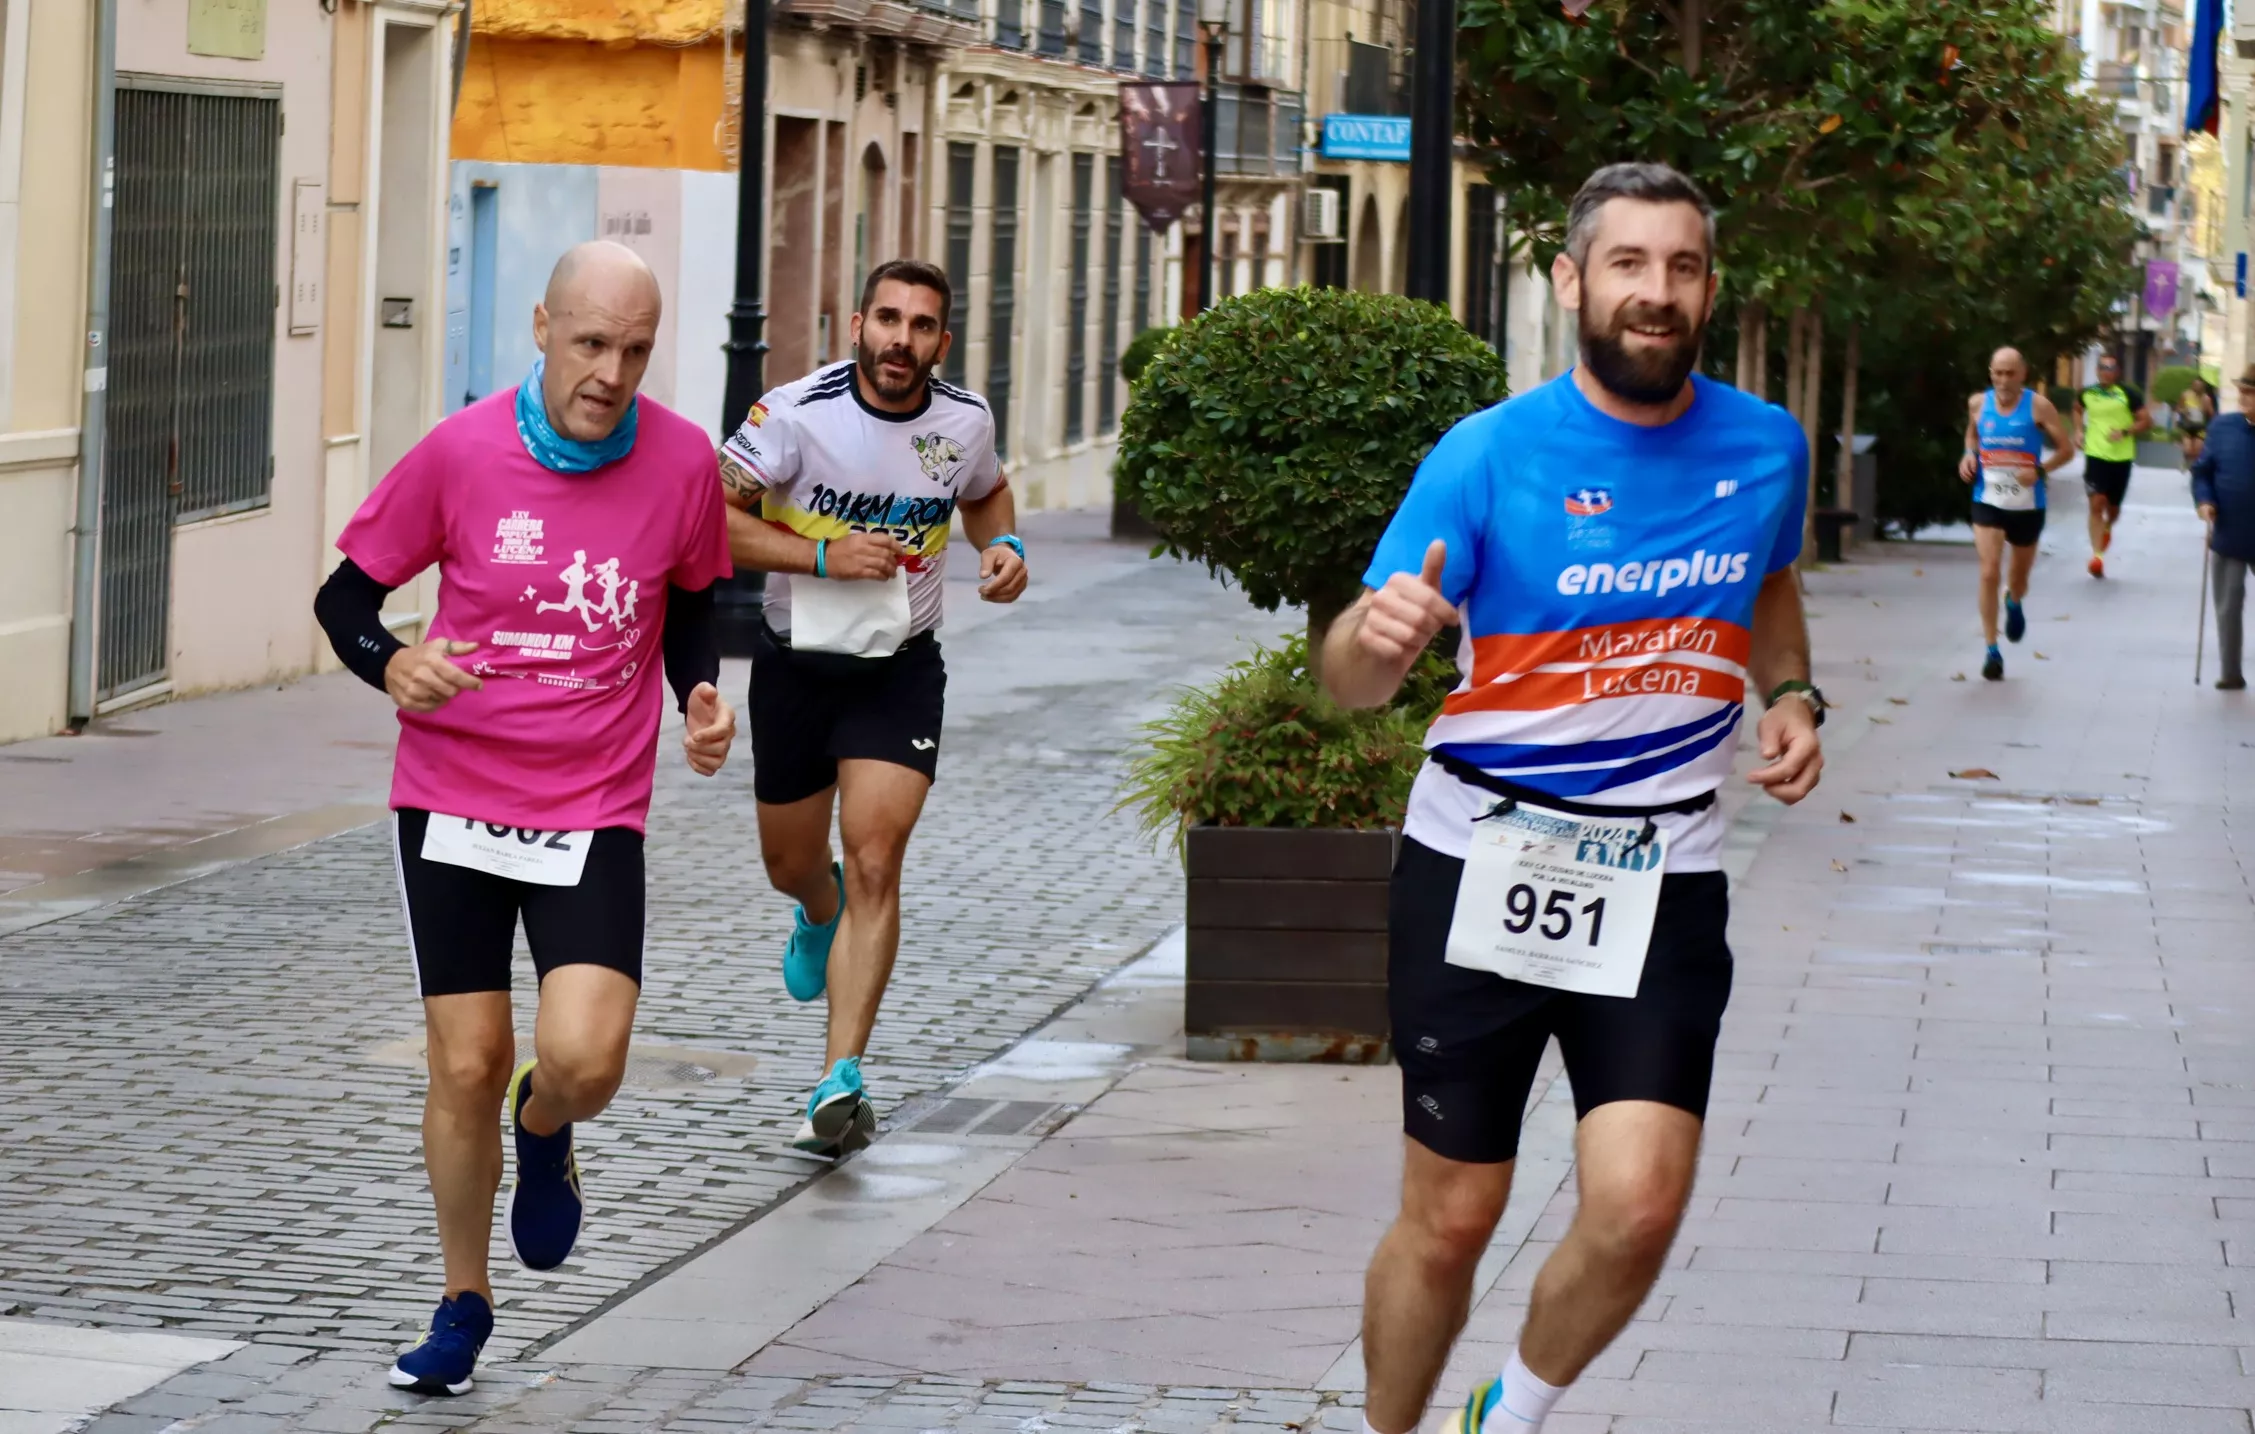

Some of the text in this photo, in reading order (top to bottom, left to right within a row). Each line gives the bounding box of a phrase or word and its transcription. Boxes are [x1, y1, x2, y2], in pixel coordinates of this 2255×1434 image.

[493, 544, 545, 555] LUCENA
[850, 525, 925, 550] 24
[1557, 549, 1750, 597] enerplus
[491, 630, 576, 651] SUMANDO KM
[1579, 621, 1718, 658] Maratón
[1583, 668, 1701, 699] Lucena
[1581, 823, 1626, 844] 2024
[1503, 883, 1606, 947] 951
